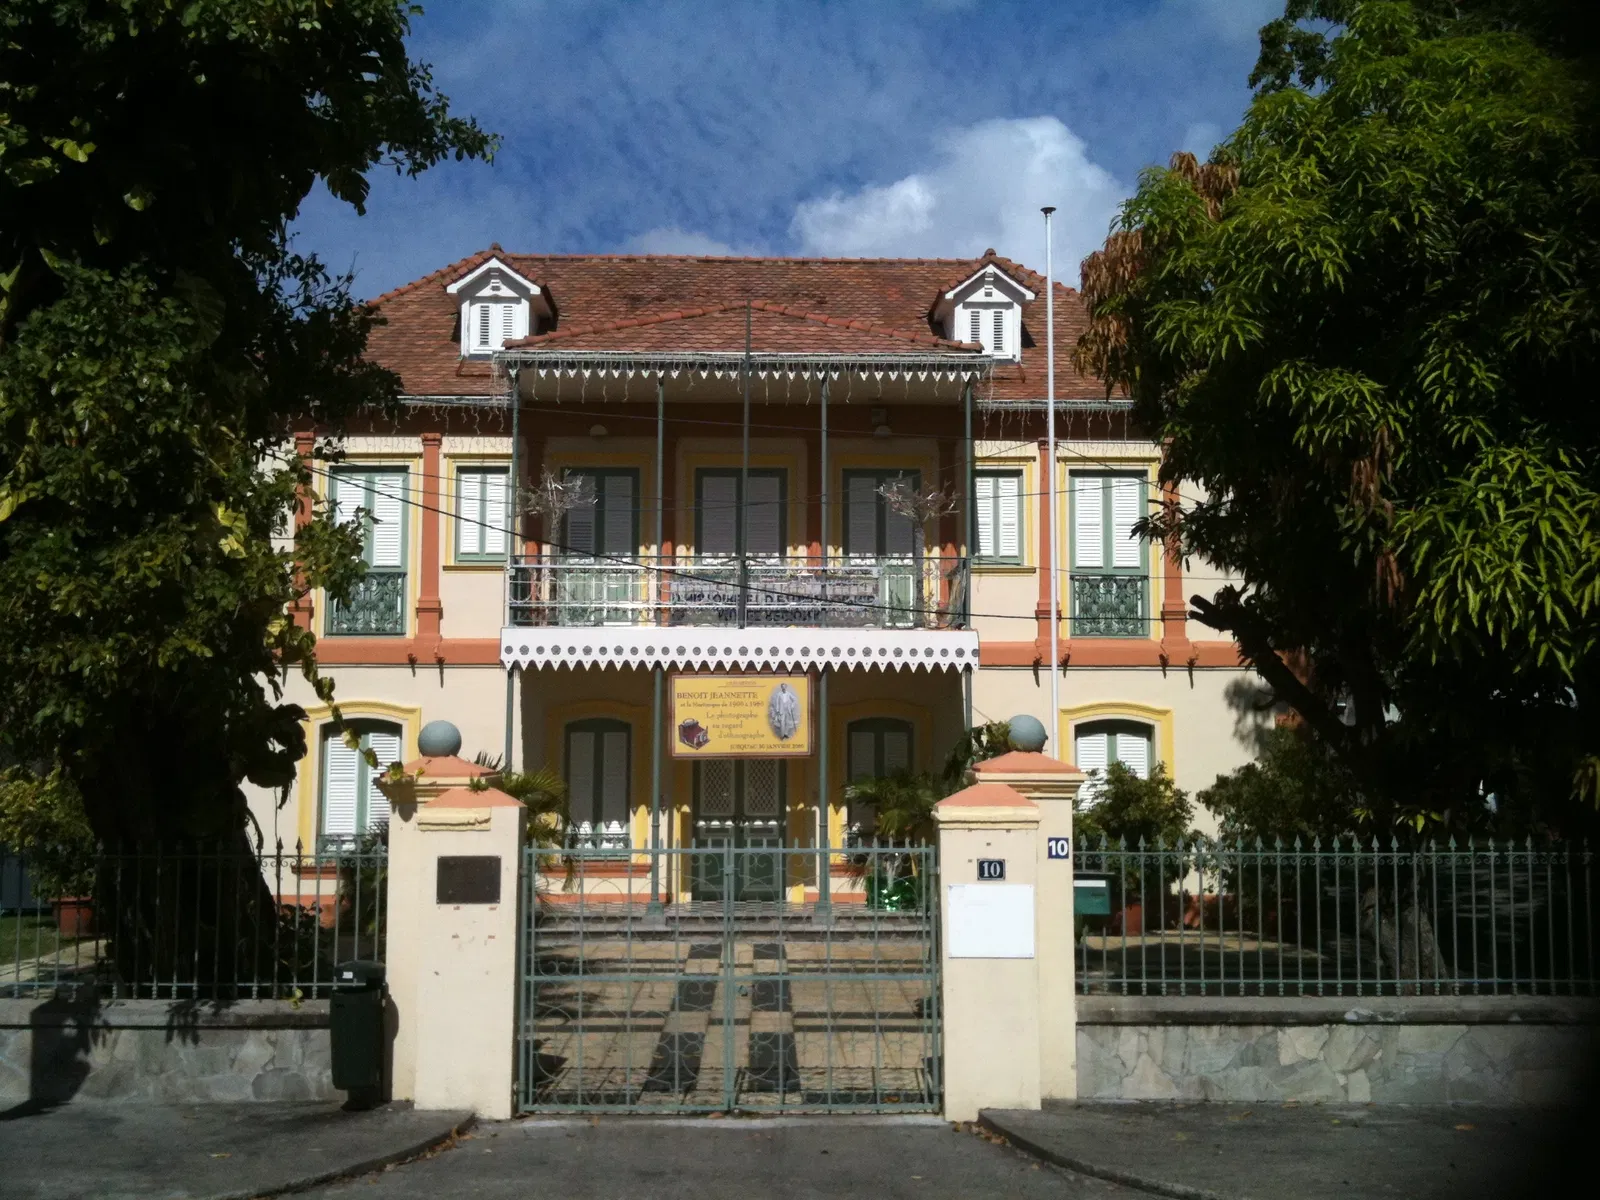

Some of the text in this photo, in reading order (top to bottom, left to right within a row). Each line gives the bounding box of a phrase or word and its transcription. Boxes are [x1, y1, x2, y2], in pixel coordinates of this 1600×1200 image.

[676, 691, 758, 700] BENOIT JEANNETTE
[1048, 840, 1068, 856] 10
[982, 861, 1000, 877] 10
